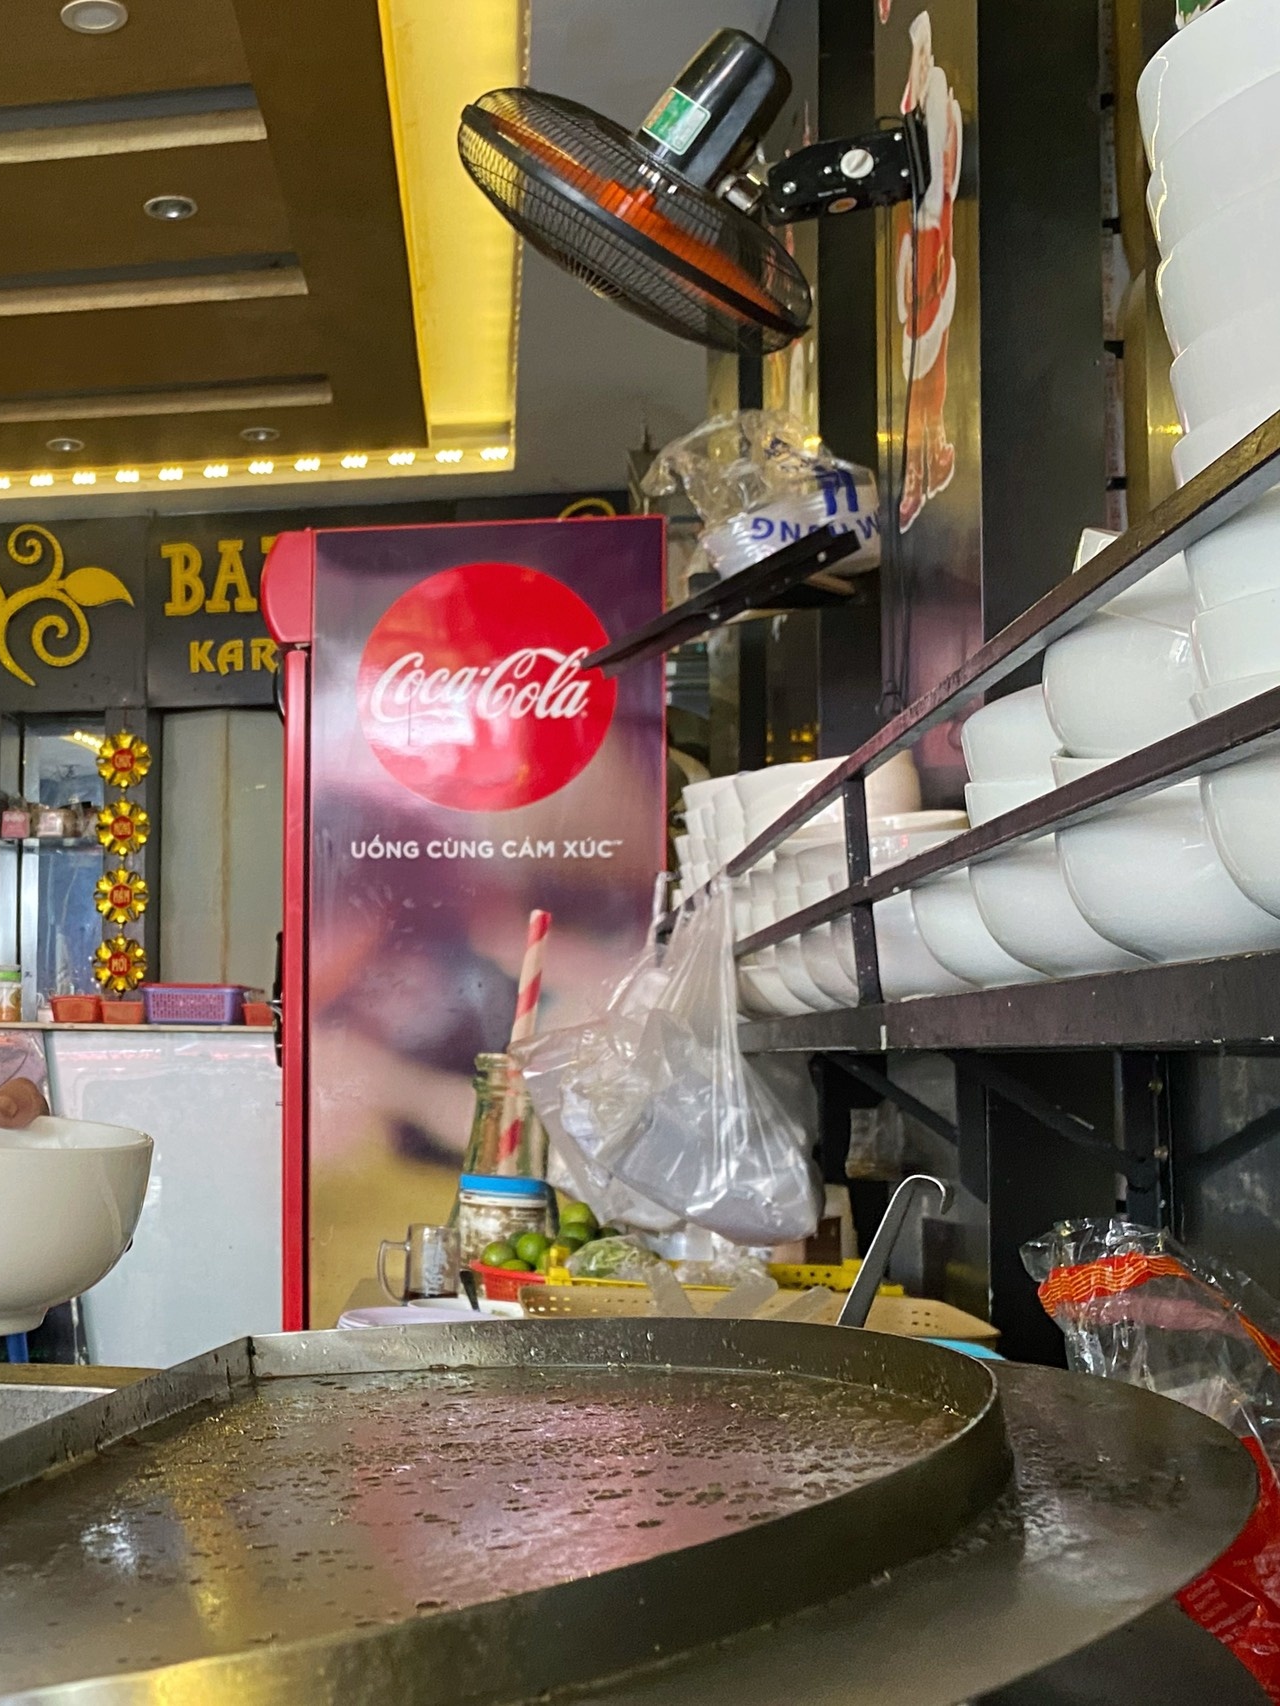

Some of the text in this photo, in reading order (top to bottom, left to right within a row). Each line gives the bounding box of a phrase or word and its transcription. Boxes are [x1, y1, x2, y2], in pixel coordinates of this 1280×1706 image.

[160, 535, 276, 616] BA
[369, 646, 592, 723] Coca-Cola
[426, 837, 494, 859] CÙNG
[501, 836, 555, 858] CẢM
